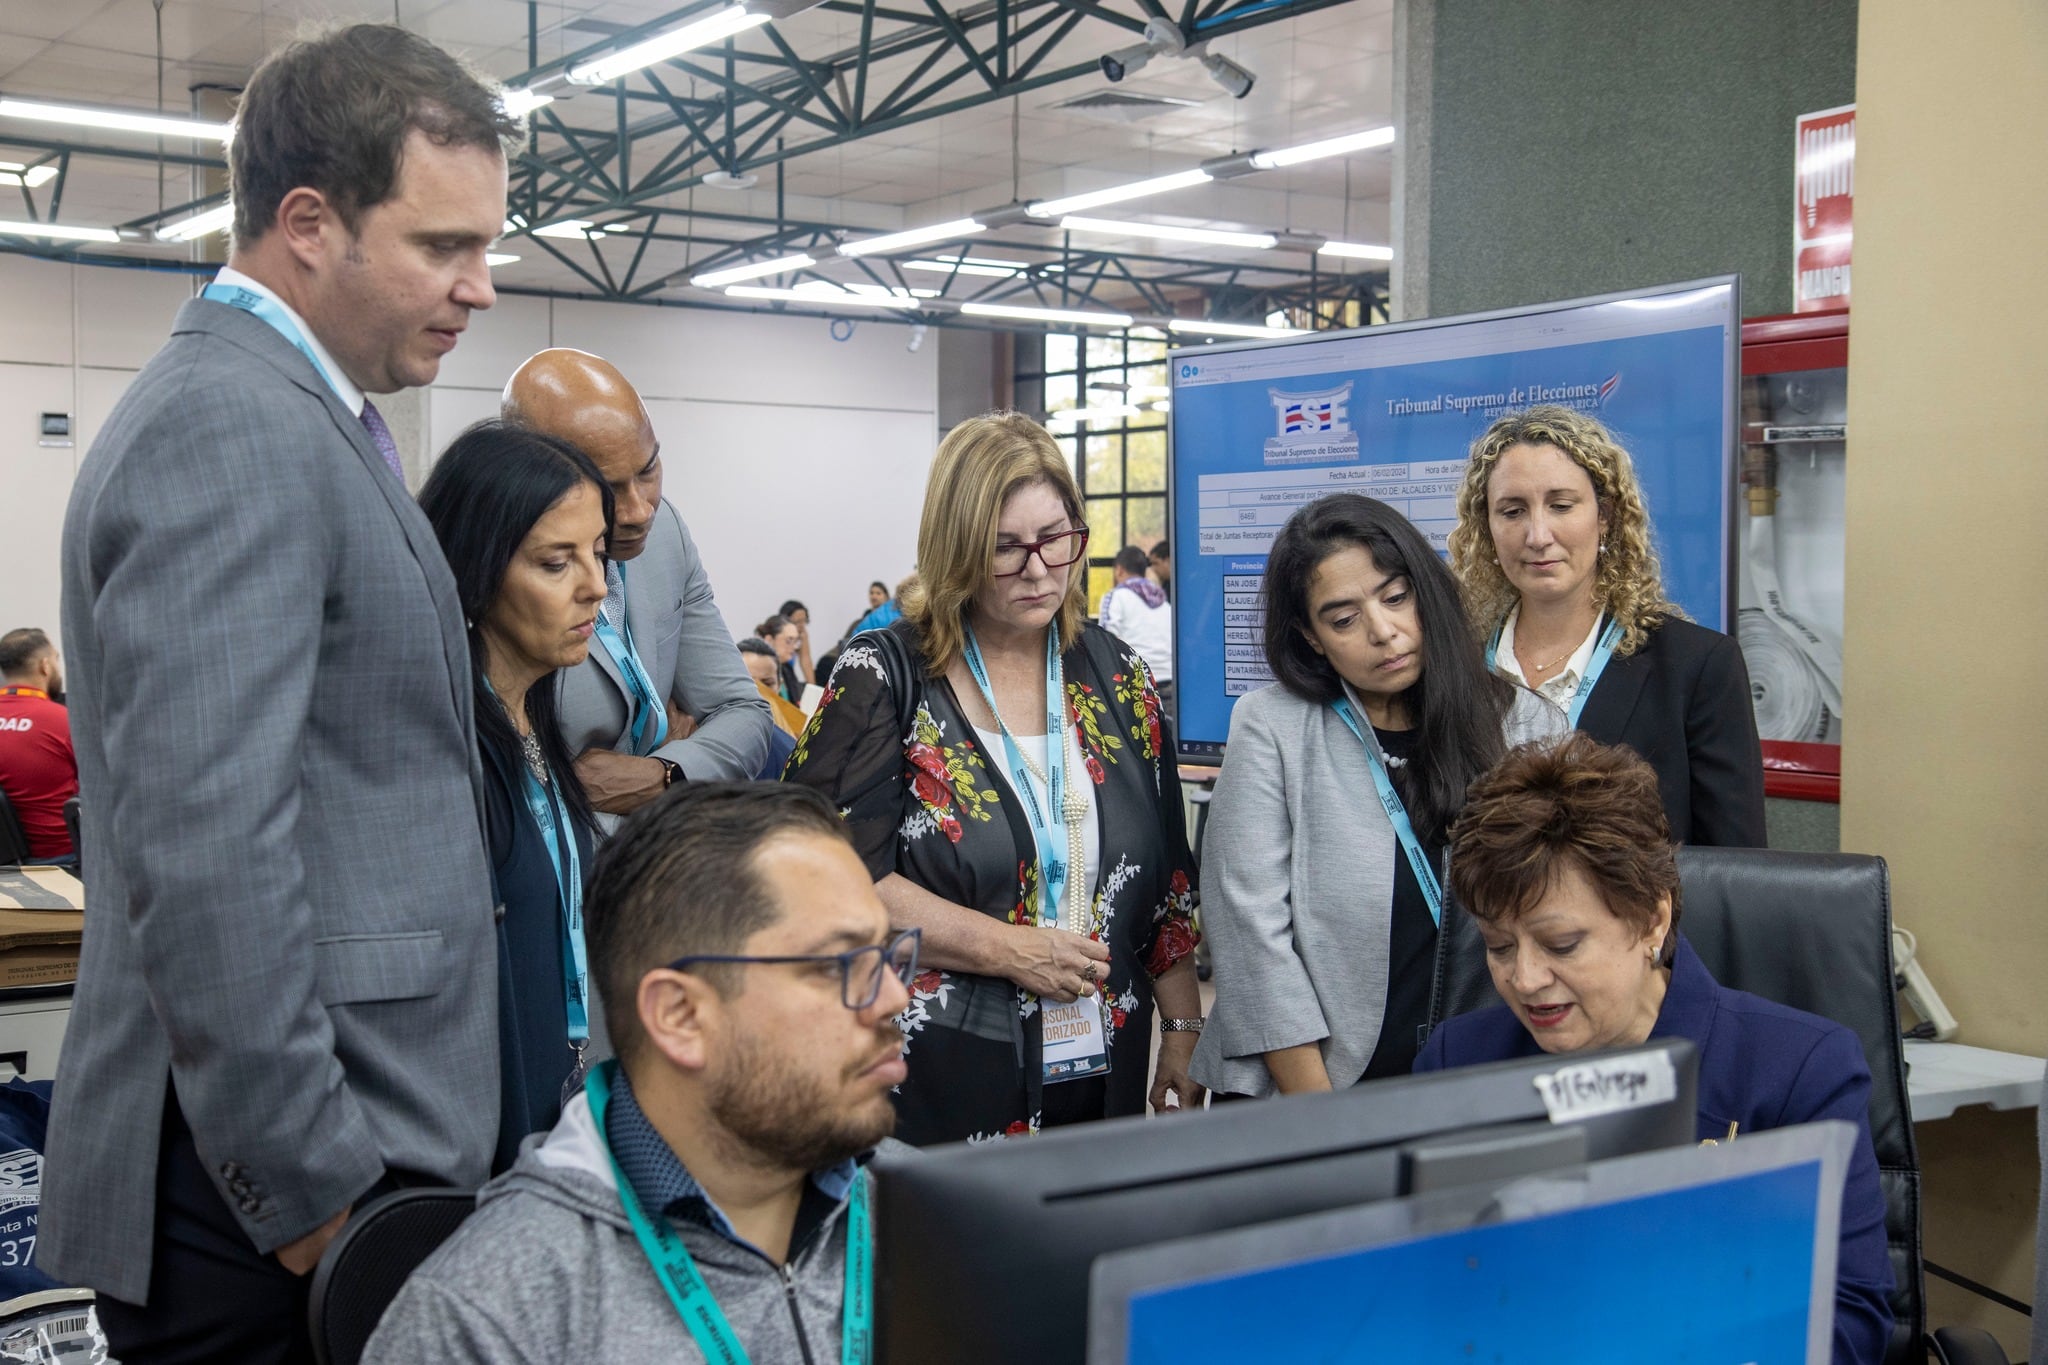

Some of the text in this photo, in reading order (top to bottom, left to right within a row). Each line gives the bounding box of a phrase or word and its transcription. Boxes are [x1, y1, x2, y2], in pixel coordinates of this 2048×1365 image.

[1386, 382, 1598, 416] Tribunal Supremo de Elecciones
[1267, 380, 1353, 436] TSE
[1265, 446, 1359, 459] Tribunal Supremo de Elecciones
[1329, 471, 1347, 480] Fecha
[1348, 470, 1366, 479] Actual
[1373, 467, 1406, 478] 06/02/2024
[1425, 465, 1439, 474] Hora
[1441, 464, 1449, 473] de
[1401, 484, 1437, 494] ALCALDES
[1260, 492, 1281, 501] Avance
[1281, 491, 1305, 500] General
[1306, 491, 1317, 501] por
[1200, 532, 1213, 541] Total
[1215, 532, 1223, 540] de
[1223, 531, 1241, 540] Juntas
[1242, 531, 1274, 540] Receptoras
[1200, 545, 1215, 553] Votos
[1226, 580, 1239, 588] SAN
[1227, 631, 1254, 640] HERED
[1227, 683, 1248, 691] LIMON
[1042, 1020, 1091, 1041] ORIZADO
[0, 1235, 37, 1267] 37
